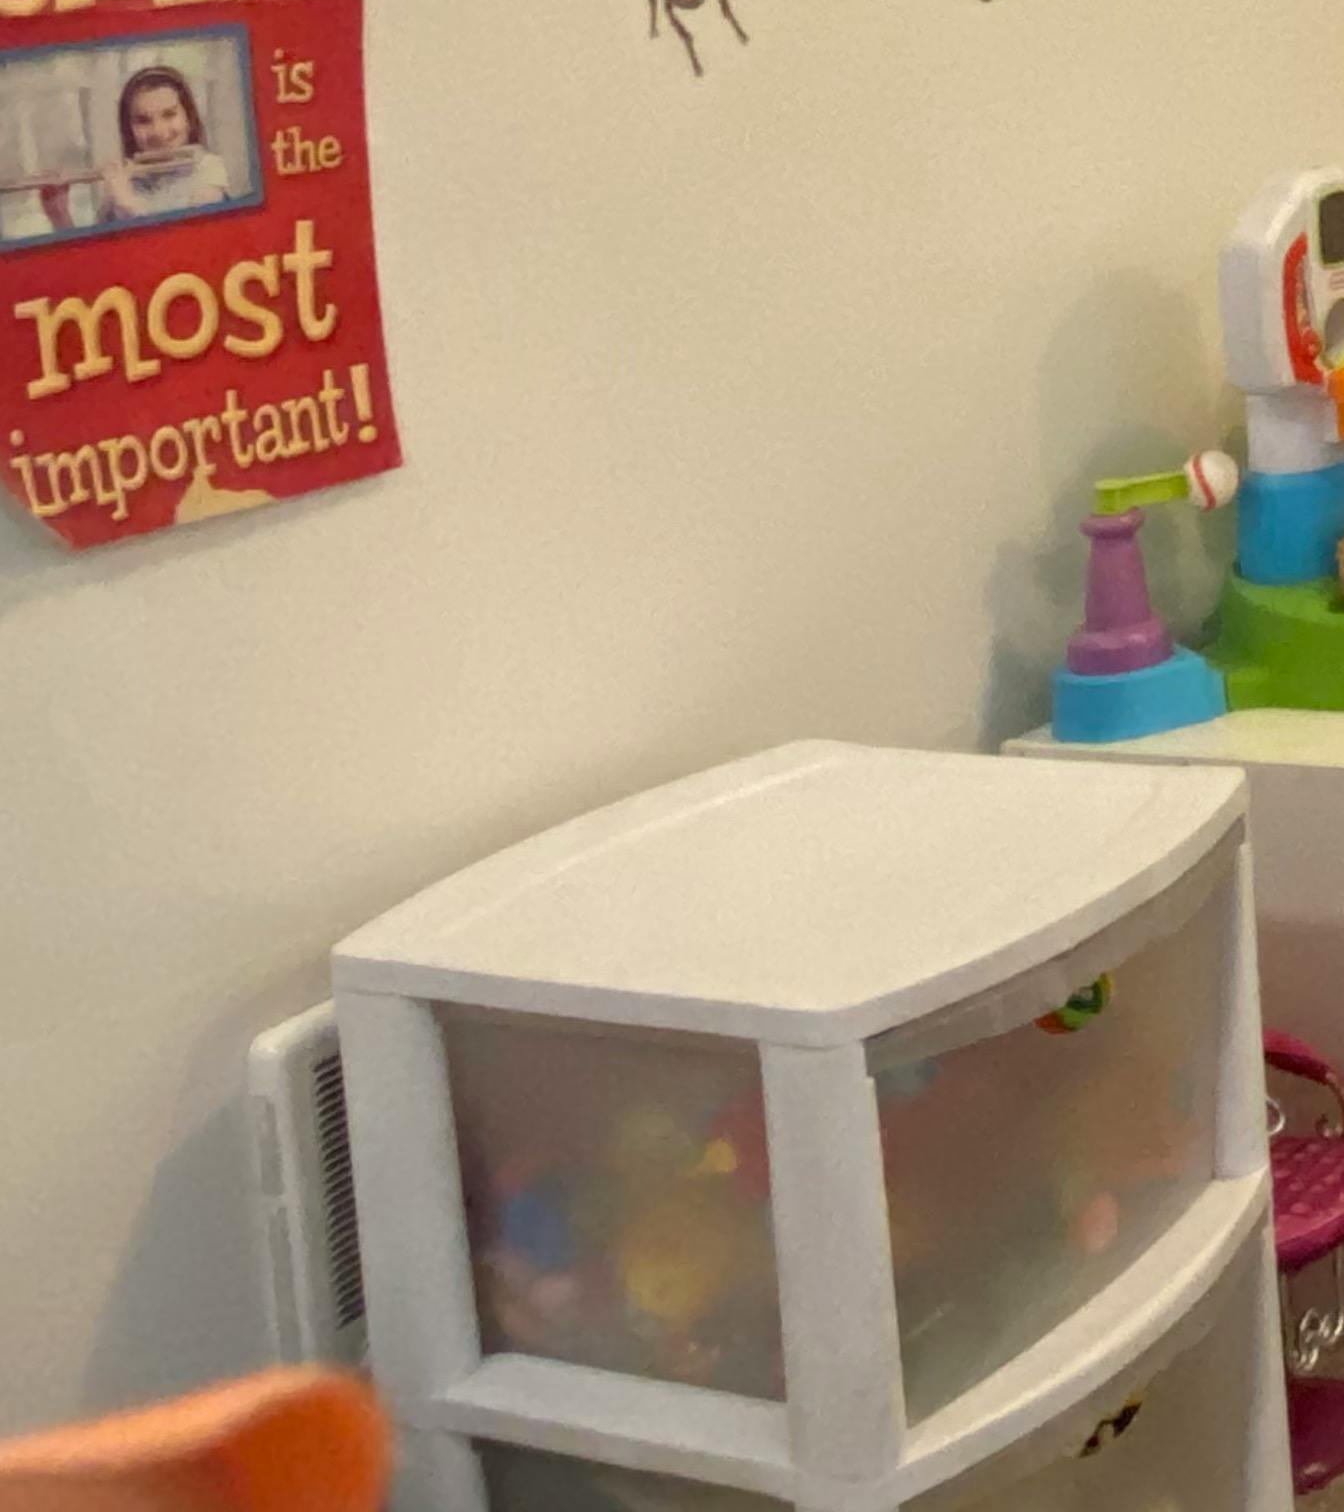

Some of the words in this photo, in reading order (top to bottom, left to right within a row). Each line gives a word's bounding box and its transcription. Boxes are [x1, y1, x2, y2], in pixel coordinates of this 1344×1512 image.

[271, 48, 315, 105] is
[271, 126, 343, 176] the
[14, 219, 338, 400] most
[10, 362, 378, 522] important!
